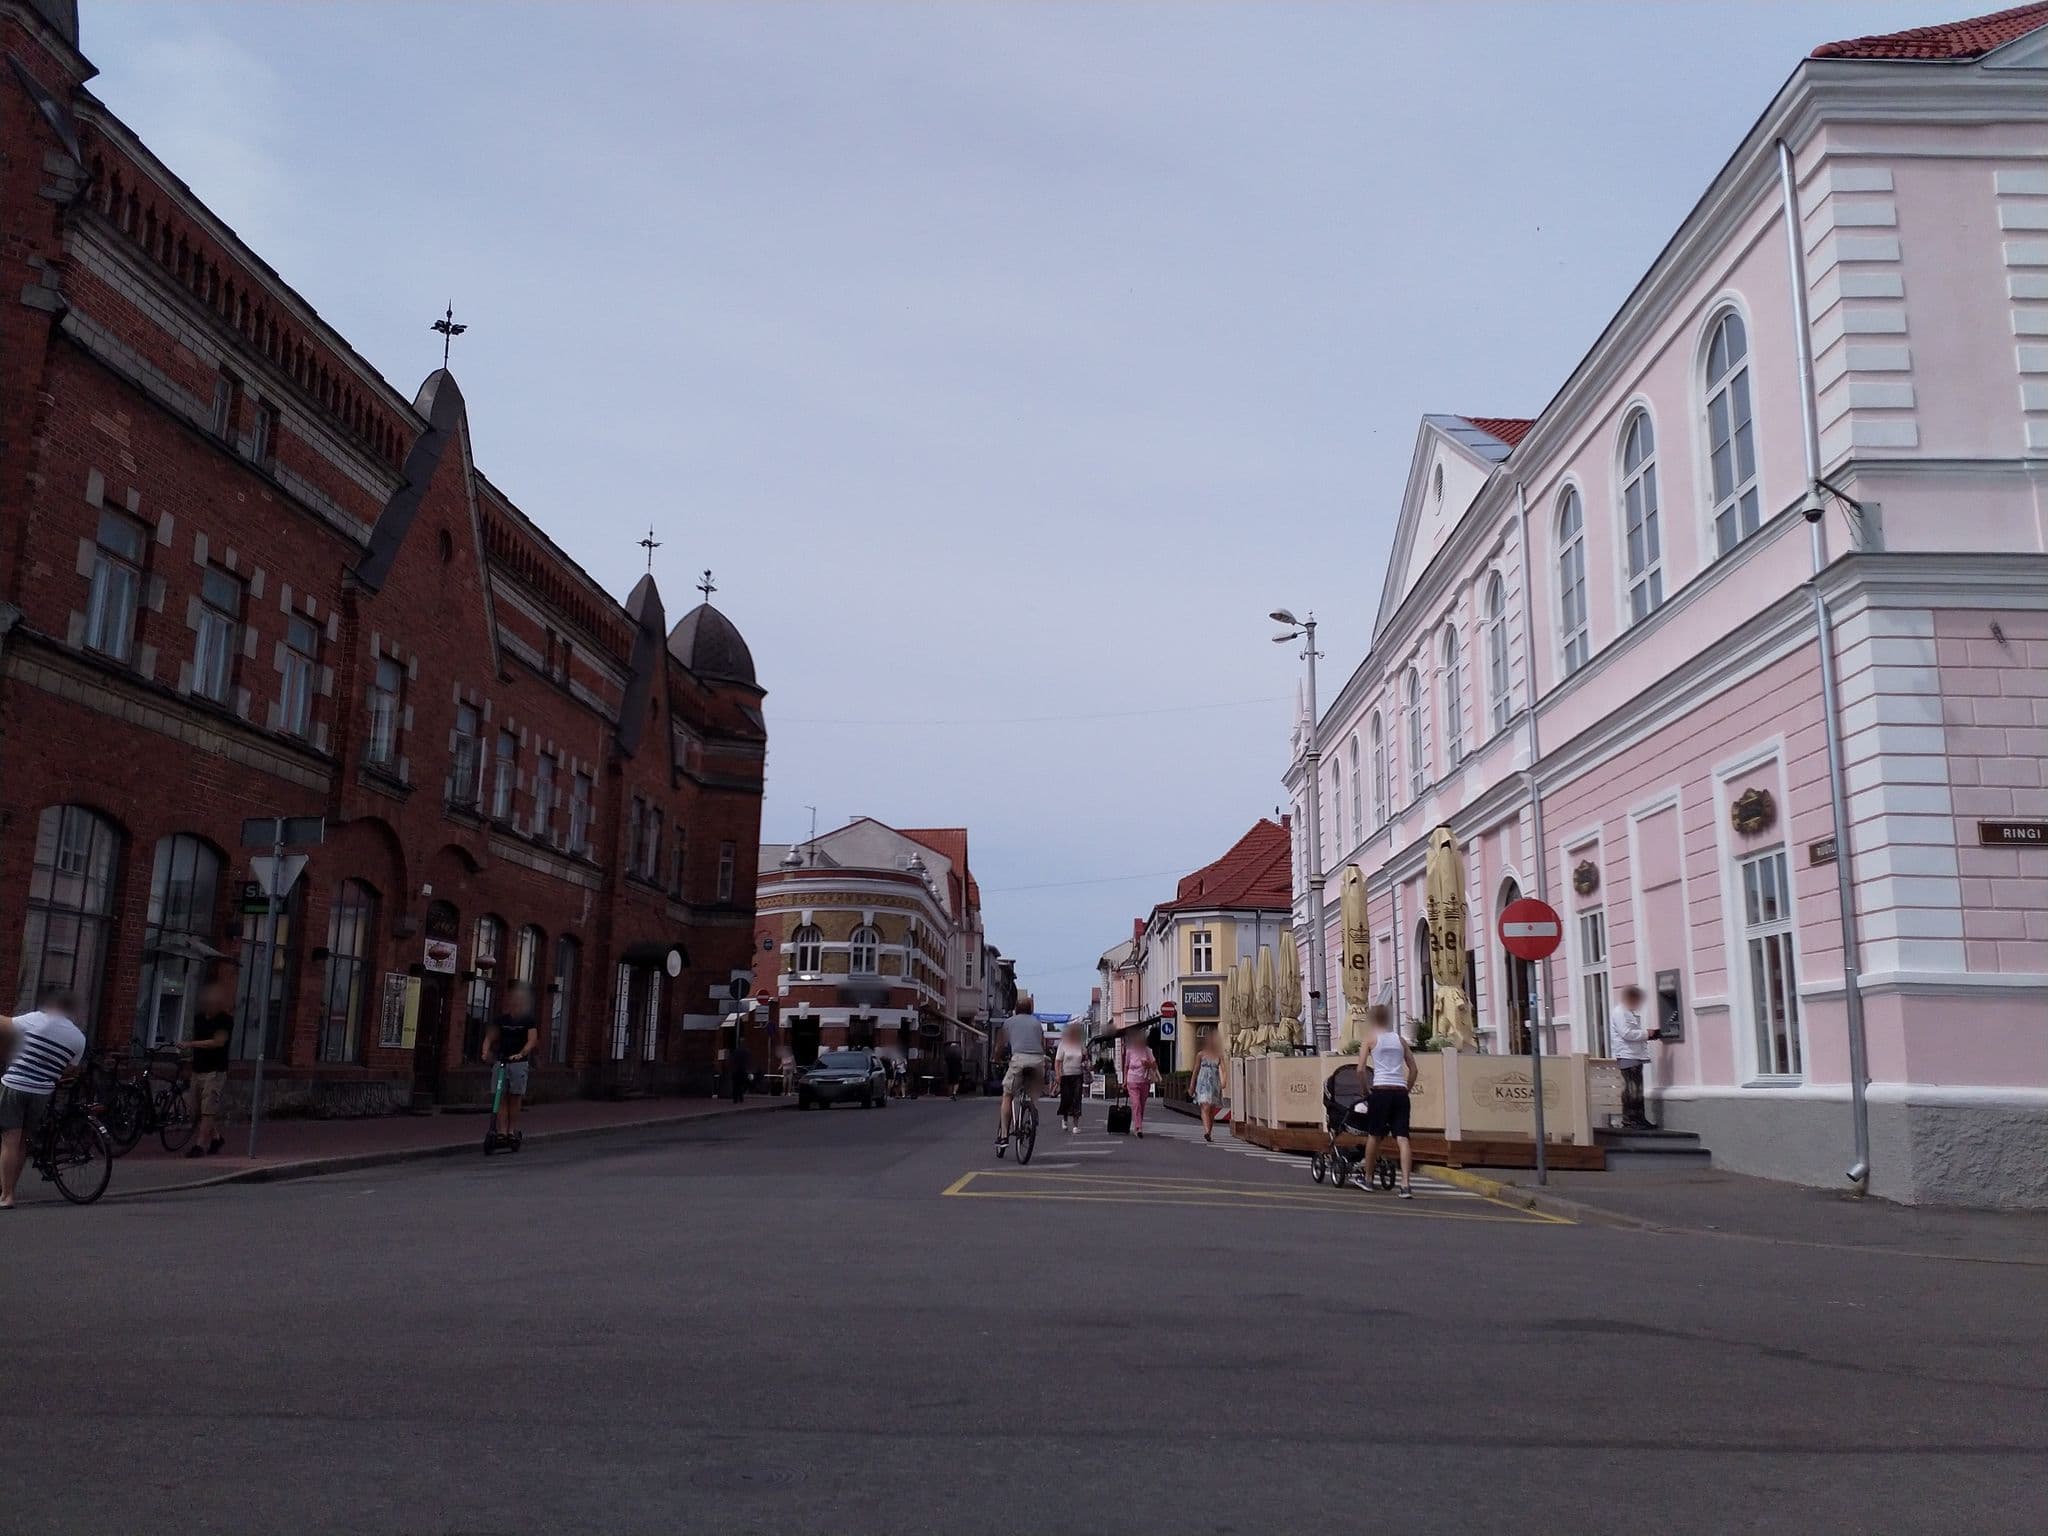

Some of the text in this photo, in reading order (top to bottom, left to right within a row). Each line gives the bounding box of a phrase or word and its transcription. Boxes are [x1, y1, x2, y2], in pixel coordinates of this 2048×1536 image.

[2003, 828, 2041, 839] RINGI
[1184, 992, 1213, 1004] EPHESUS
[1495, 1086, 1536, 1099] KASSA
